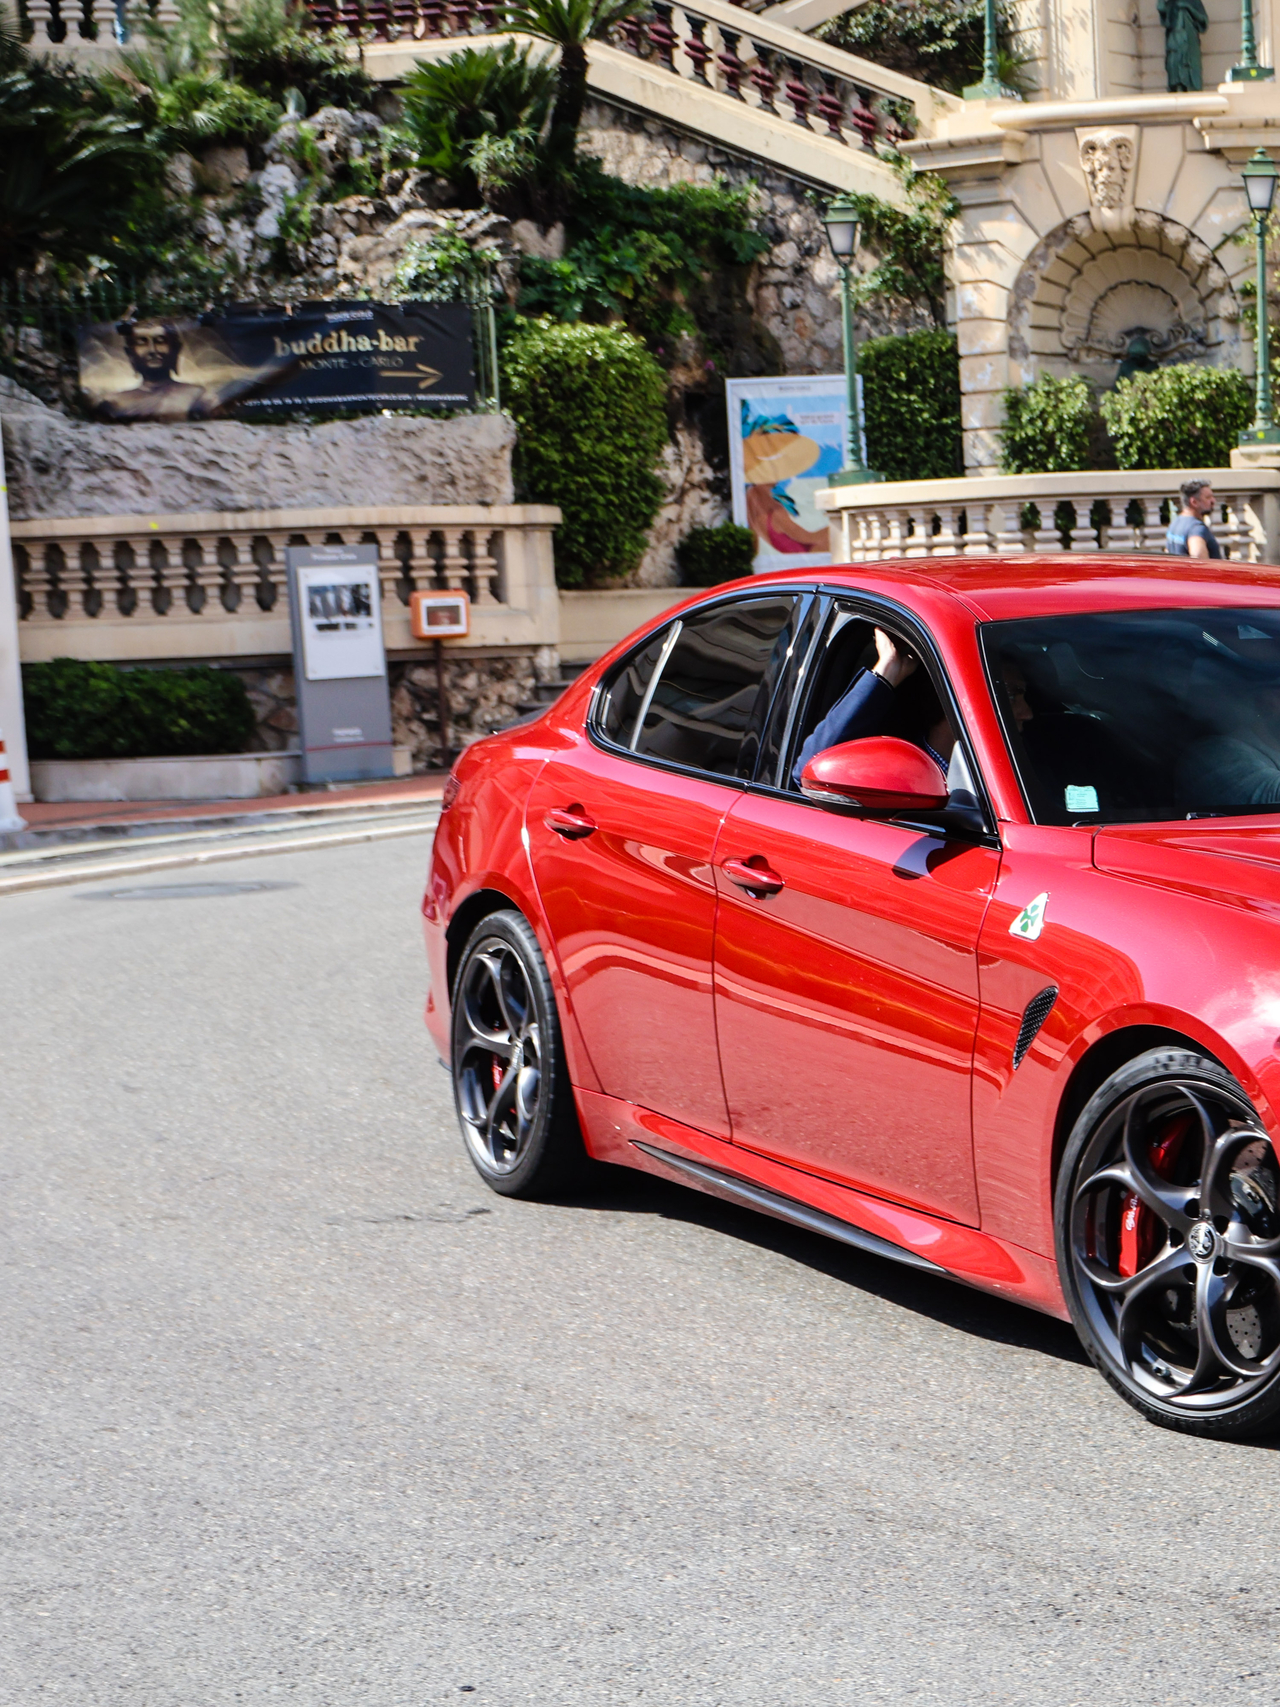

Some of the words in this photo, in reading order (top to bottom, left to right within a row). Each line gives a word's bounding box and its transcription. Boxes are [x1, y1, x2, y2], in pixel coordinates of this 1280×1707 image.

[273, 329, 420, 357] buddha-bar
[301, 358, 349, 371] MONTE
[359, 355, 404, 368] CARLO
